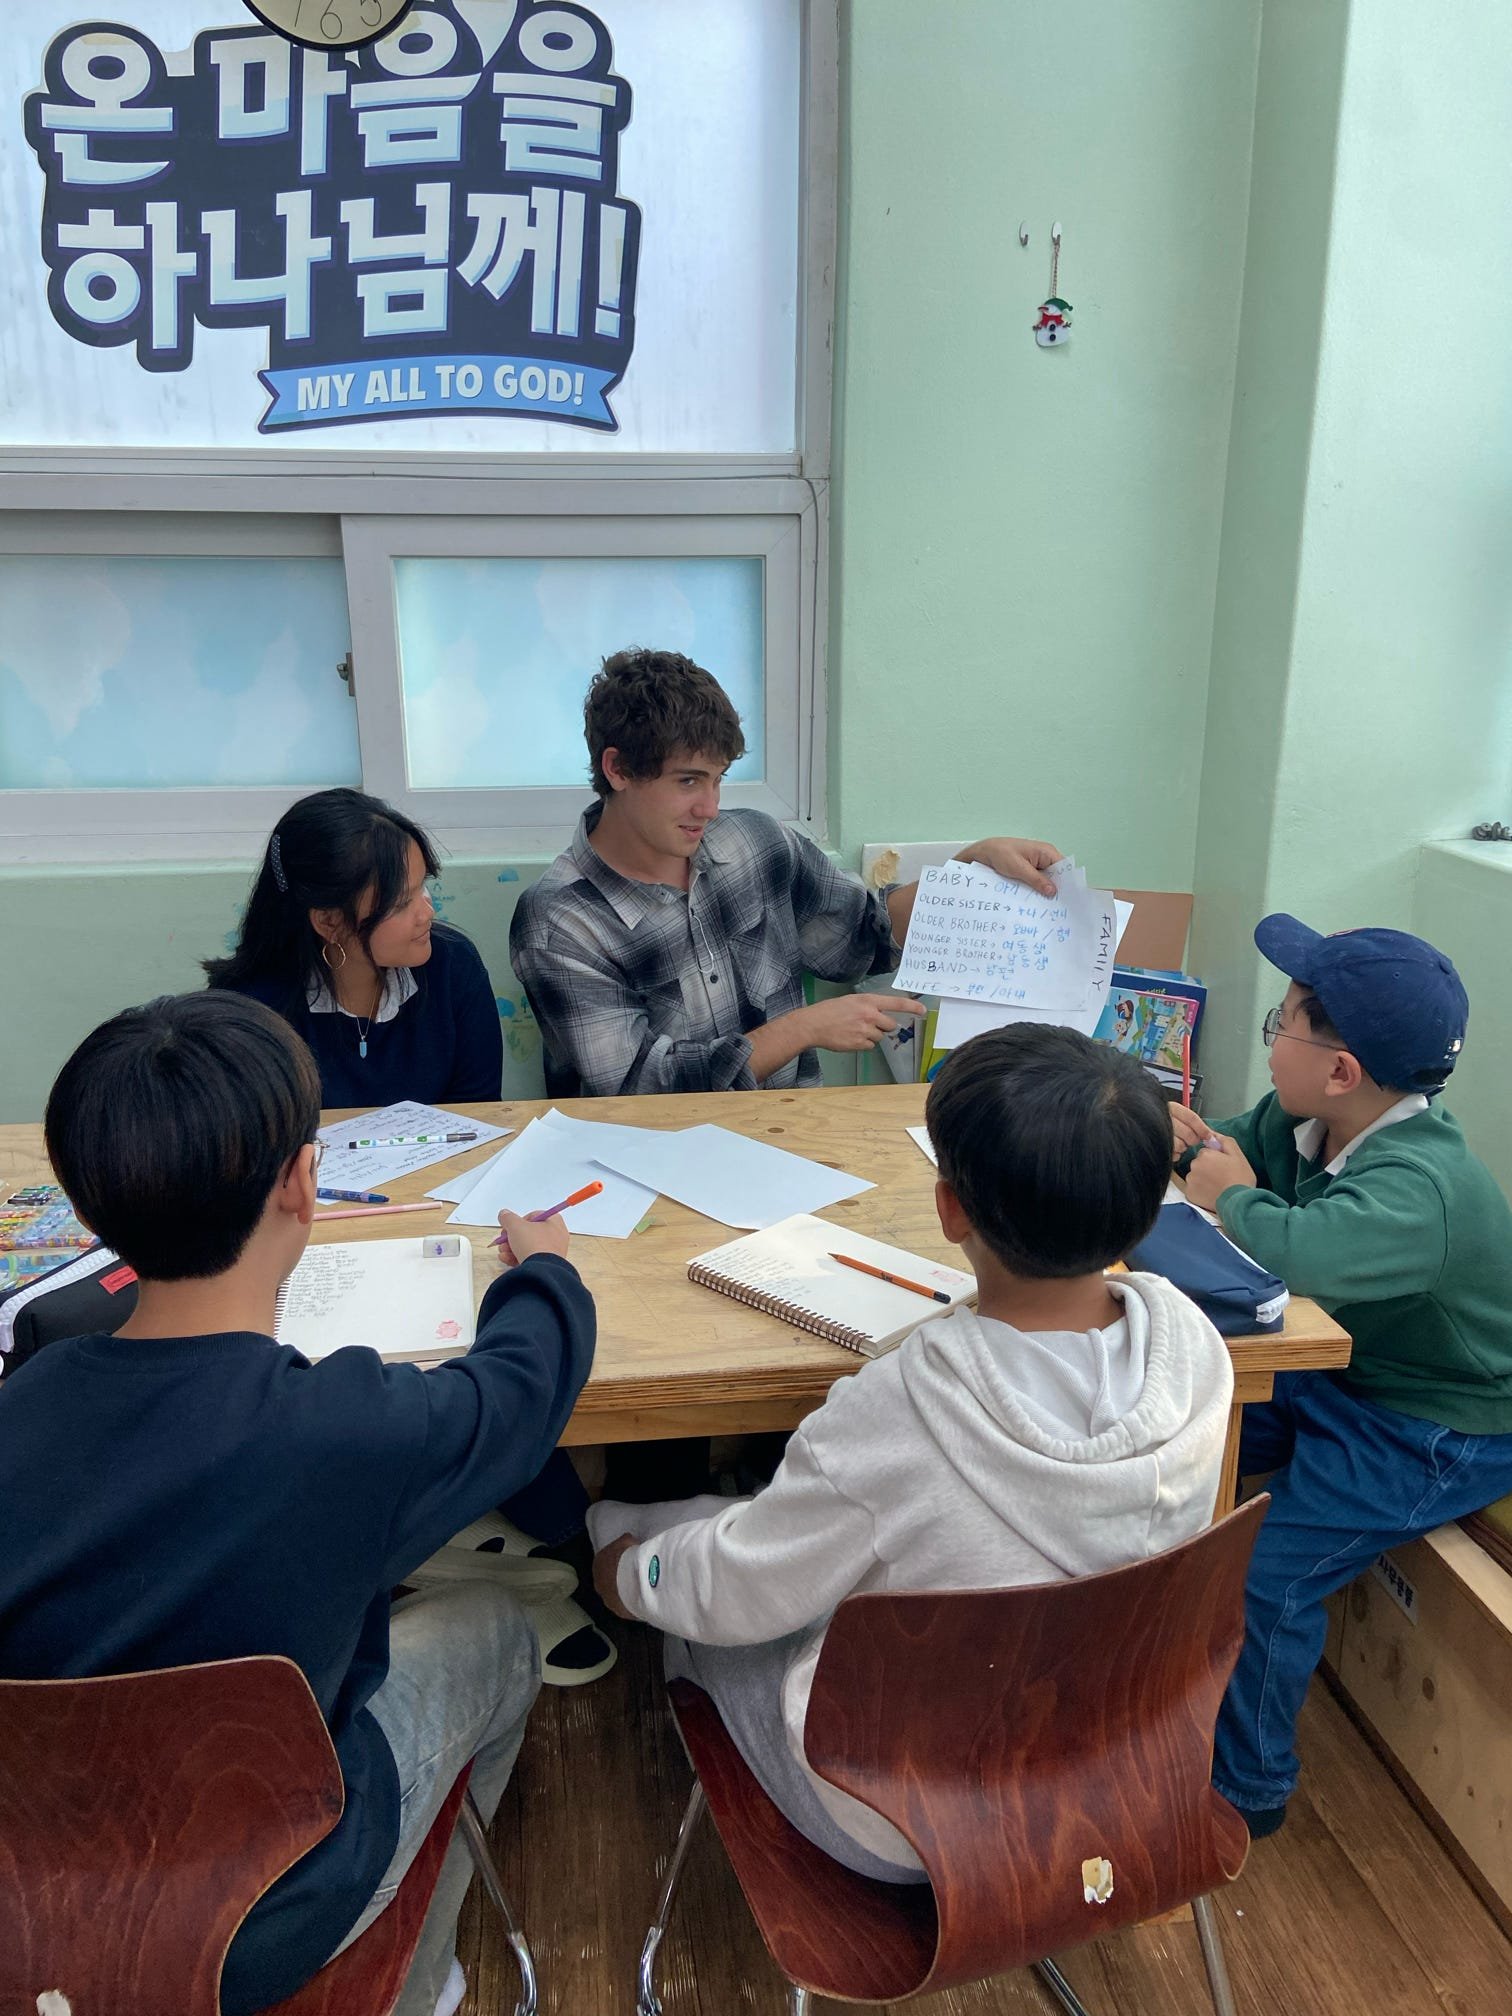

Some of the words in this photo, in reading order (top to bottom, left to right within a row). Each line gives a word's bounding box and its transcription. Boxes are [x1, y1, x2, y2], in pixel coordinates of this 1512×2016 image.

[41, 33, 174, 185] 온
[211, 9, 617, 181] 마음을
[57, 183, 628, 350] 하나님께!
[297, 373, 356, 411] MY
[364, 367, 427, 404] ALL
[435, 364, 484, 399] TO
[493, 364, 584, 405] GOD!
[925, 869, 974, 887] BABY
[994, 882, 1020, 896] 아기
[919, 892, 954, 907] OLDER
[958, 898, 1001, 912] SISTER
[1050, 907, 1068, 922] 언니
[914, 911, 945, 929] OLDER
[951, 916, 998, 934] BROTHER
[910, 929, 951, 945] YOUNGER
[956, 935, 988, 949] SISTER
[908, 943, 949, 957] YOUNGER
[955, 947, 997, 962] BROTHER
[905, 958, 968, 975] HUSBAND
[900, 977, 942, 993] WIFE
